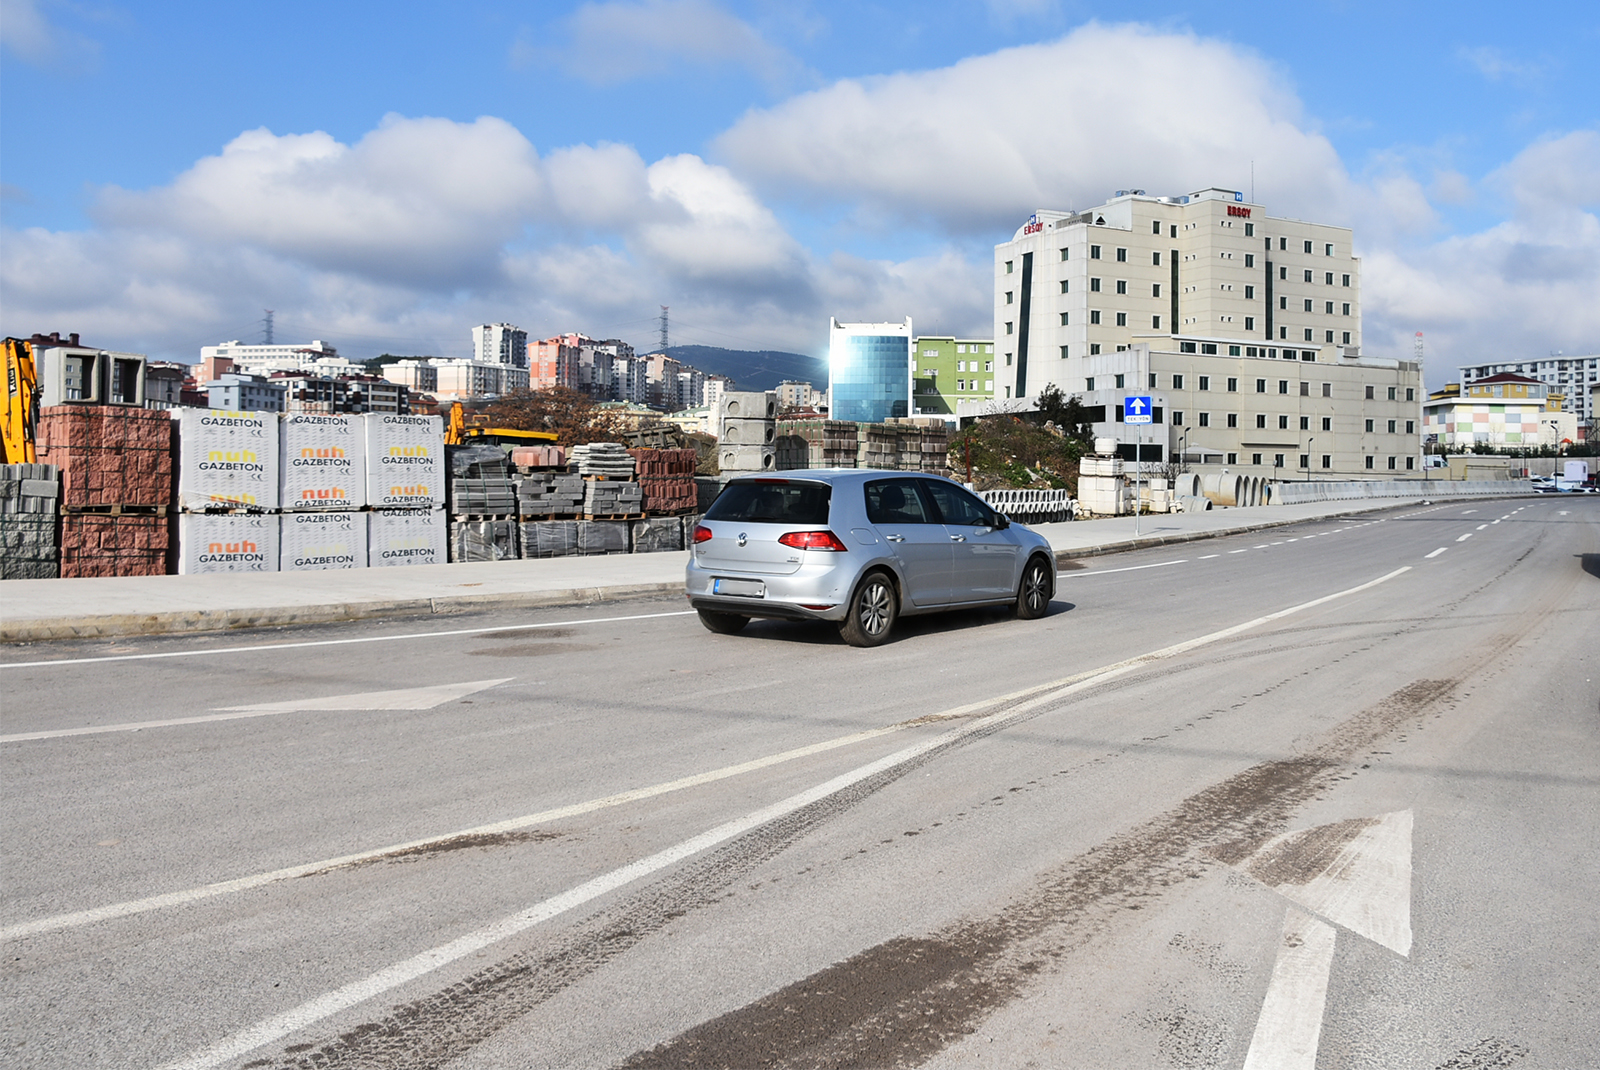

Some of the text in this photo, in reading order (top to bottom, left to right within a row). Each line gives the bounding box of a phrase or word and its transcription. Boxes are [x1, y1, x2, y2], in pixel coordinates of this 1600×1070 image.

[1227, 205, 1251, 218] ERSOY
[1024, 222, 1043, 235] ERSOY
[201, 417, 263, 427] GAZBETON
[295, 415, 348, 425] GAZBETON
[383, 416, 430, 425] GAZBETON
[301, 446, 344, 458] nuh
[389, 445, 428, 456] nuh
[208, 449, 256, 463] nuh
[381, 456, 433, 465] GAZBETON
[199, 462, 263, 471] GAZBETON
[293, 458, 351, 467] GAZBETON
[302, 487, 345, 499] nuh
[390, 484, 428, 496] nuh
[295, 499, 351, 507] GAZBETON
[382, 509, 431, 517] GAZBETON
[295, 514, 351, 523] GAZBETON
[208, 540, 256, 553] nuh
[199, 553, 263, 563] GAZBETON
[382, 548, 435, 558] GAZBETON
[294, 555, 354, 566] GAZBETON
